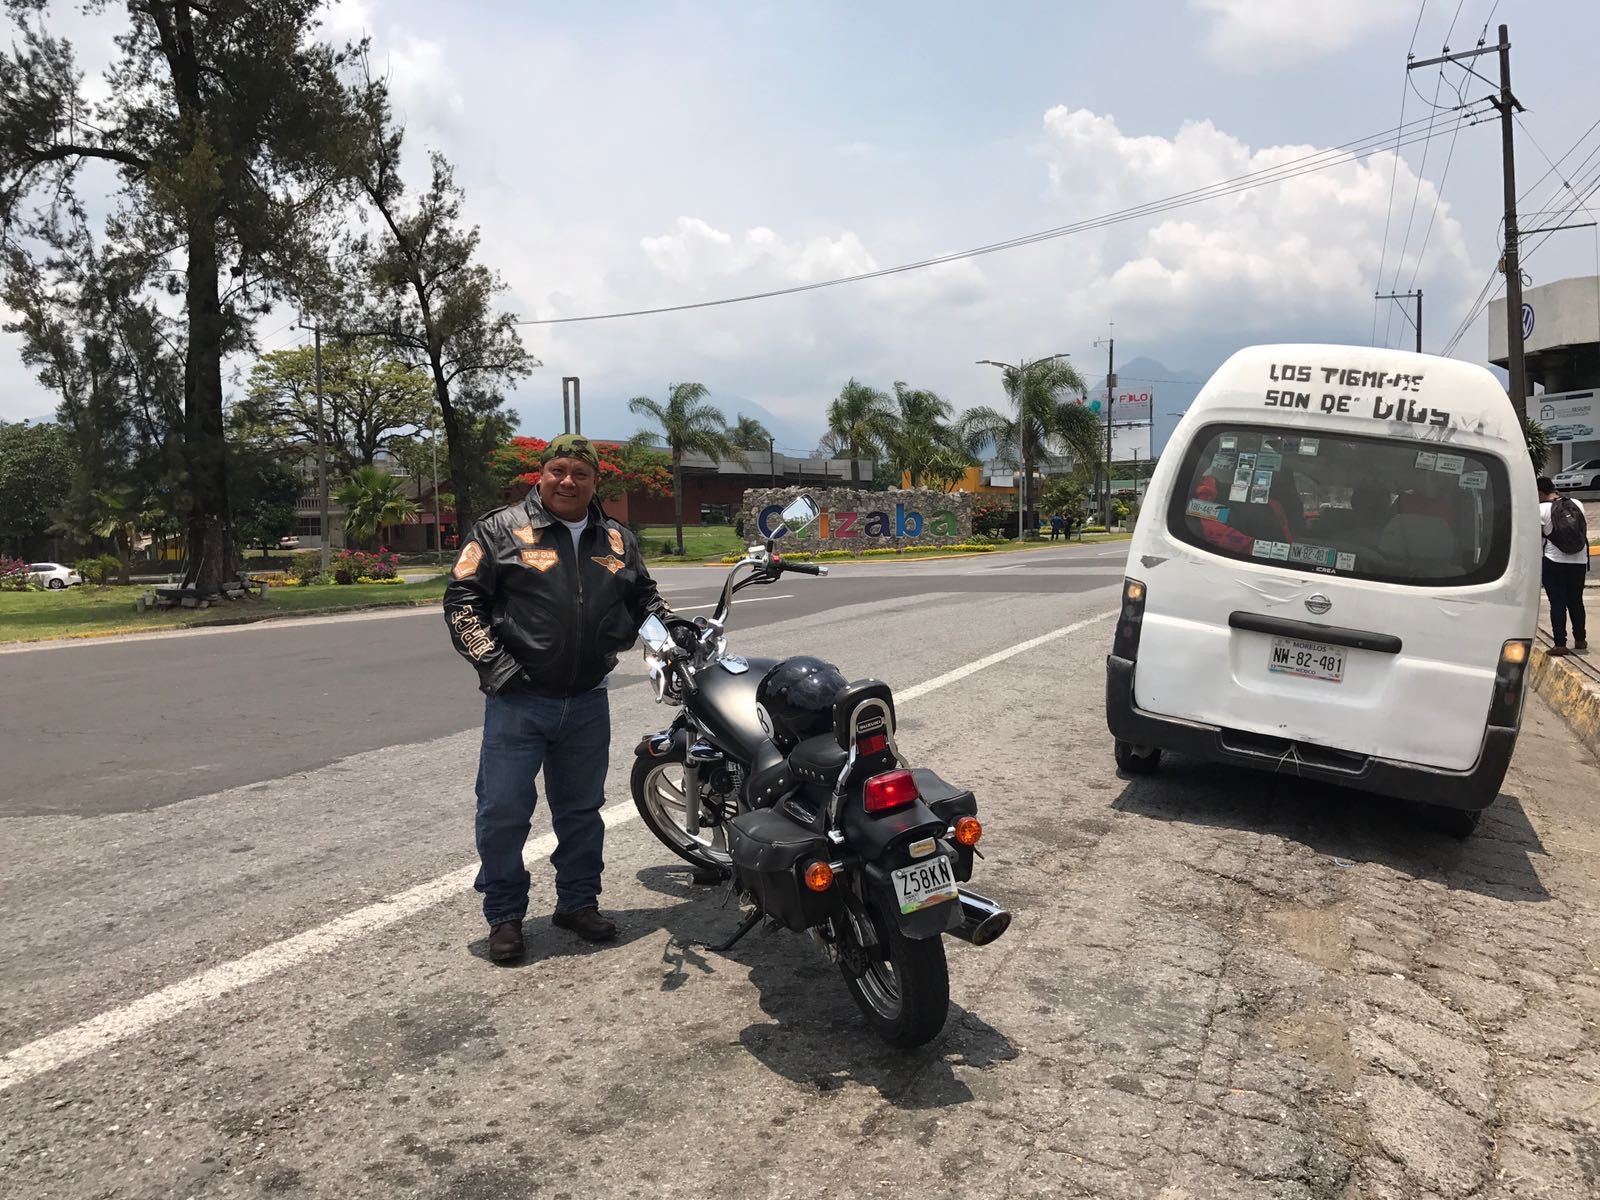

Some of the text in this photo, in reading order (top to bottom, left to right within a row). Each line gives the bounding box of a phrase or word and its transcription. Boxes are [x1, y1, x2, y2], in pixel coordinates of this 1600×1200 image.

[1270, 364, 1312, 382] LOS
[1264, 389, 1311, 409] SON
[1320, 394, 1352, 414] DE
[758, 503, 958, 539] Oizaba
[1293, 641, 1327, 653] MORELOS
[1273, 647, 1342, 673] NW-82-481
[901, 862, 951, 897] Z58KN
